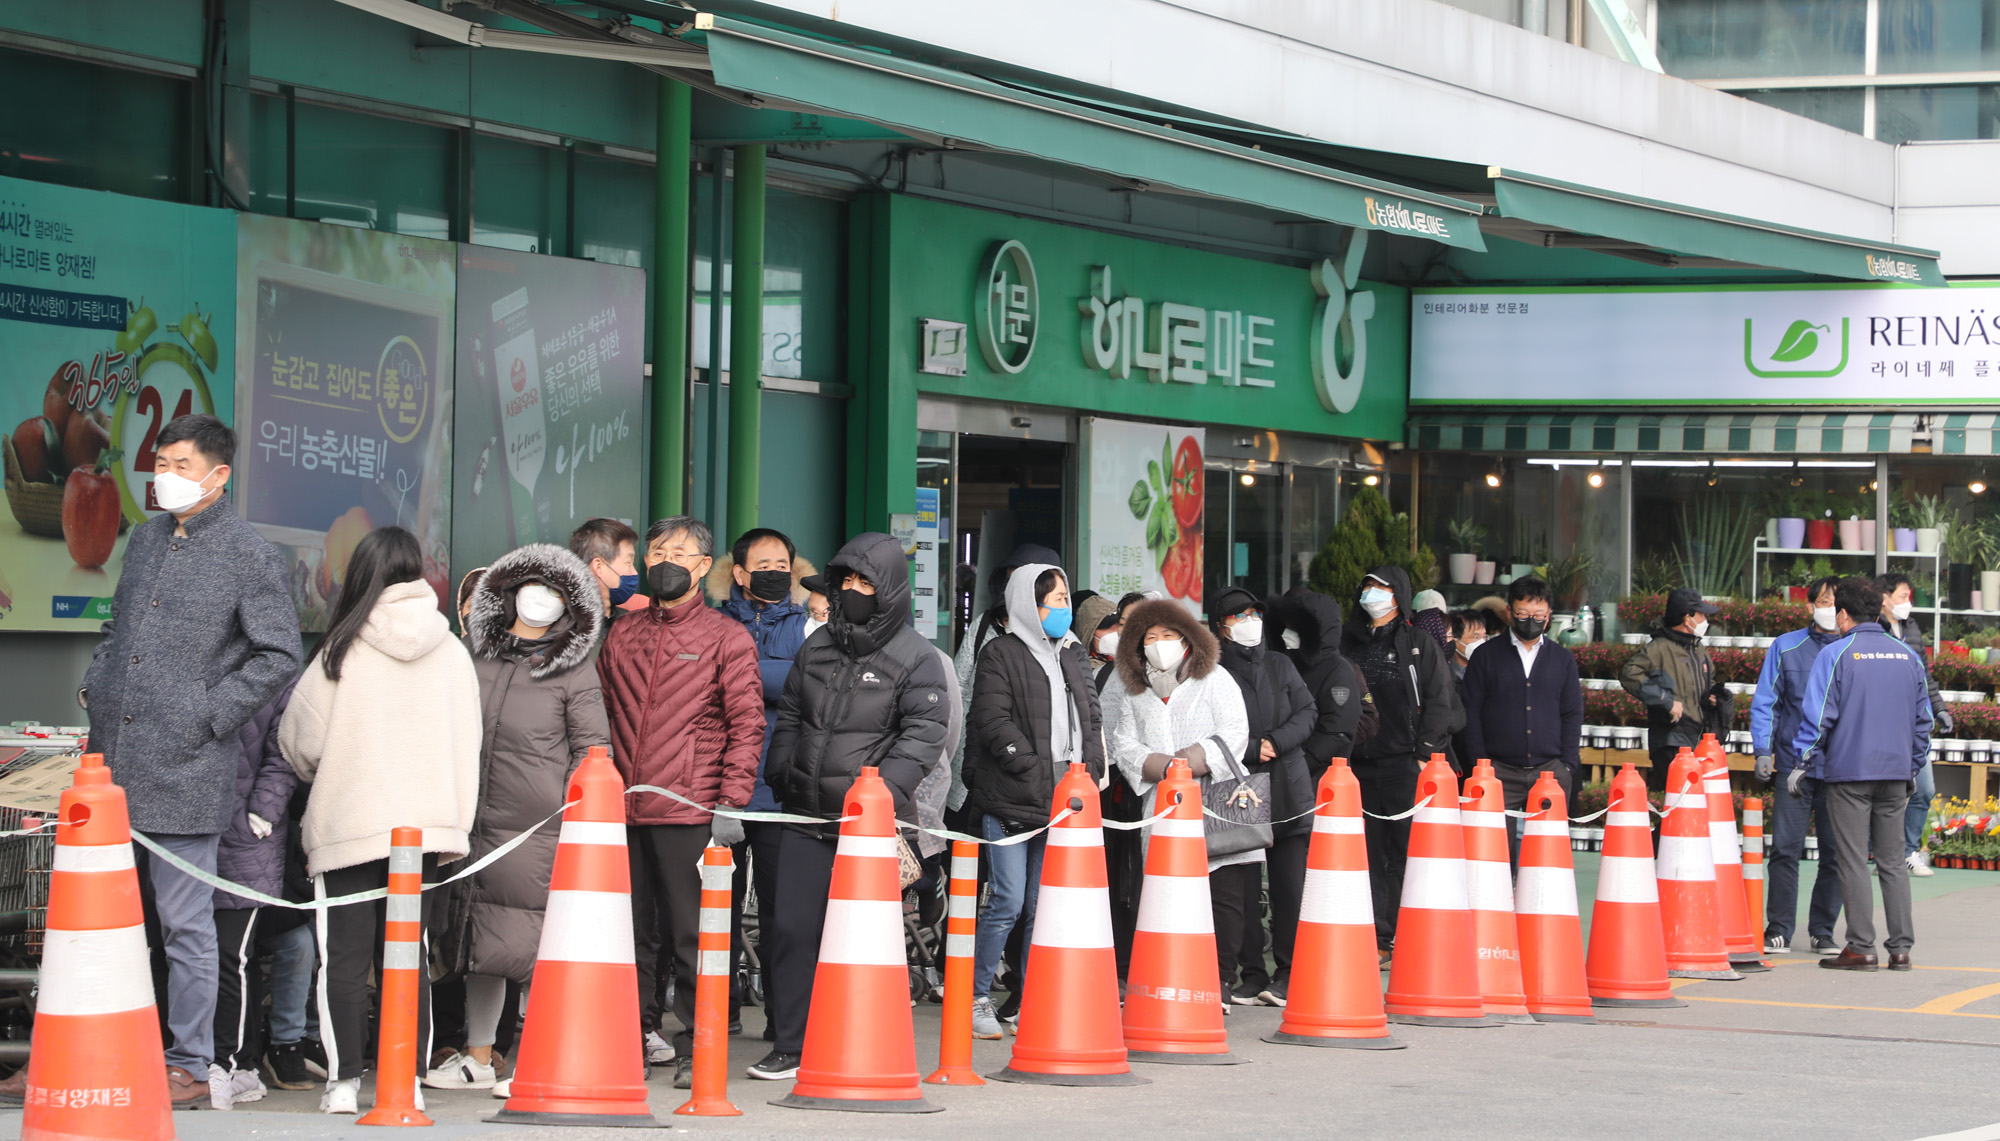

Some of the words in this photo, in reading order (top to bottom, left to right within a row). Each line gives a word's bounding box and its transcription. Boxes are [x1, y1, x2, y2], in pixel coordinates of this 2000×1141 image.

[34, 219, 74, 243] 열려있는
[56, 252, 96, 279] 양재점!
[29, 294, 69, 319] 신선함이
[71, 300, 123, 324] 가득합니다.
[1079, 264, 1276, 388] 하나로마트
[1423, 302, 1490, 314] 인테리어화분
[1496, 302, 1529, 314] 전문점
[64, 349, 140, 411] 365일
[271, 351, 321, 391] 눈감고
[326, 363, 372, 401] 집어도
[545, 361, 567, 394] 좋은
[568, 342, 599, 380] 우유를
[599, 329, 620, 362] 위한
[1974, 360, 2000, 378] 플
[383, 368, 417, 425] 좋은
[548, 381, 580, 422] 당신의
[581, 369, 602, 404] 선택
[56, 603, 69, 611] NH
